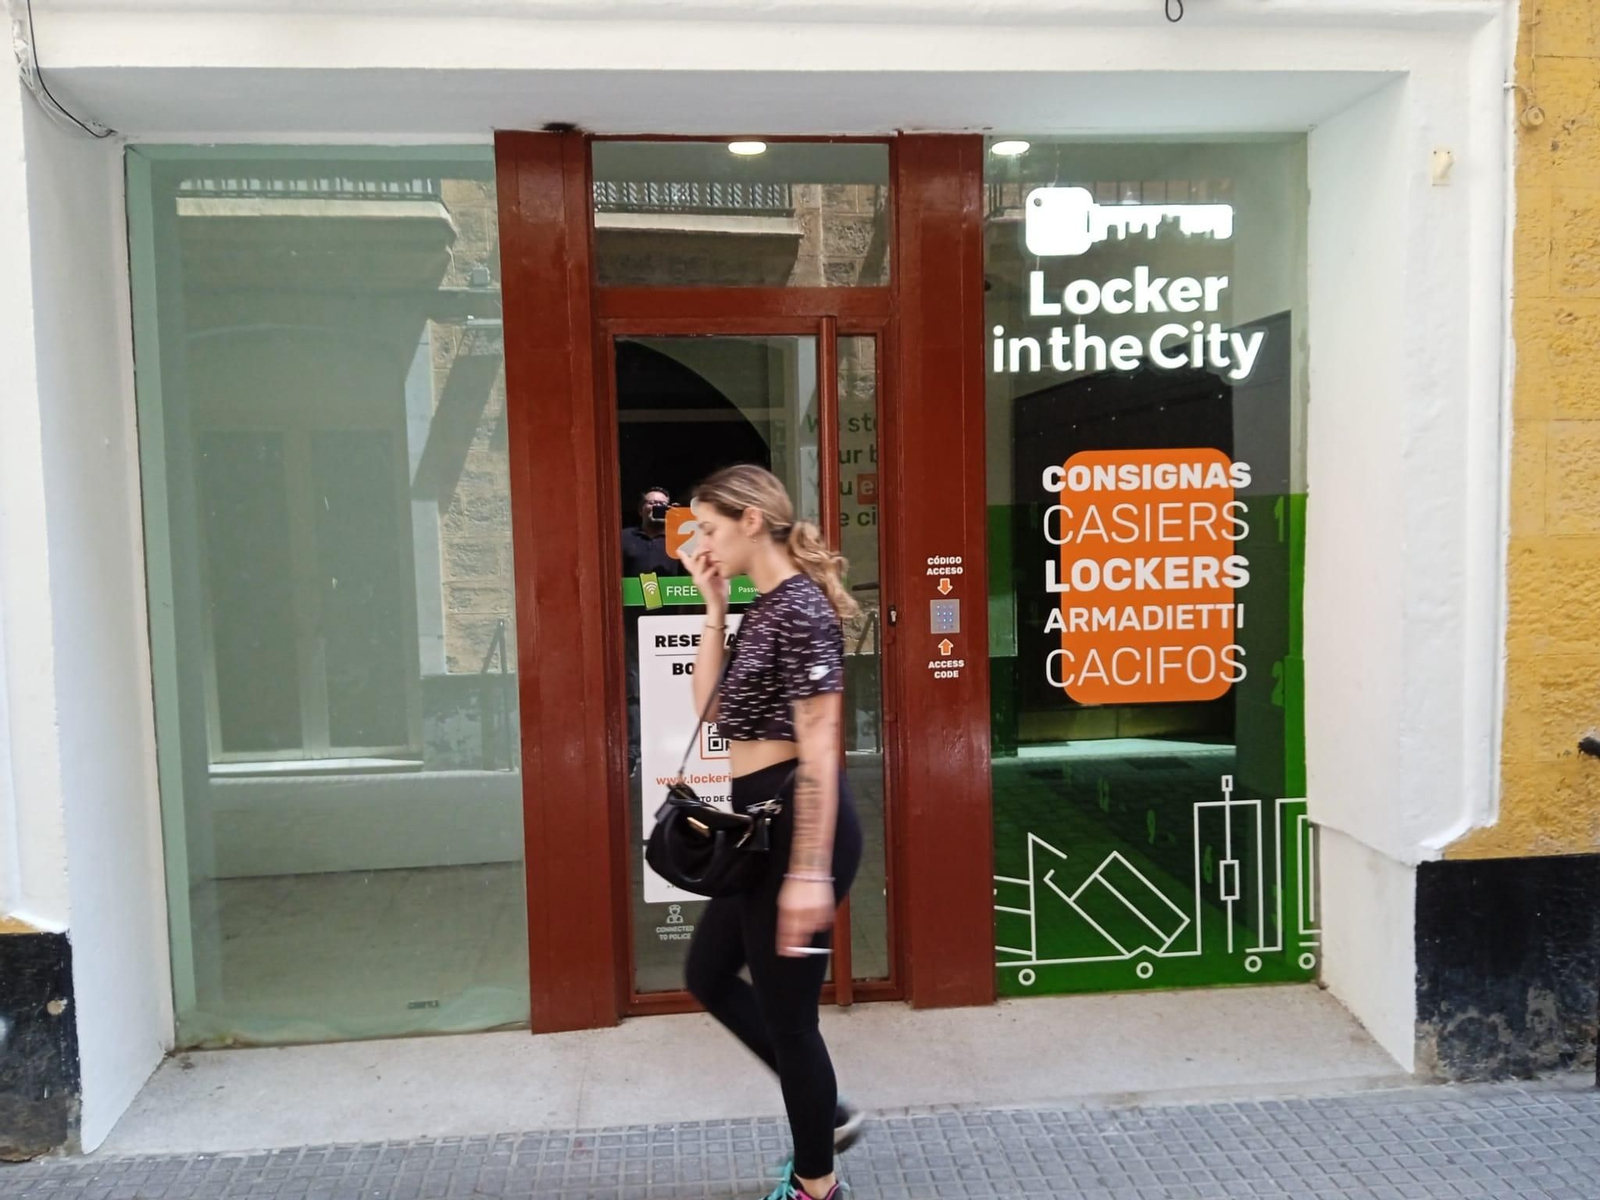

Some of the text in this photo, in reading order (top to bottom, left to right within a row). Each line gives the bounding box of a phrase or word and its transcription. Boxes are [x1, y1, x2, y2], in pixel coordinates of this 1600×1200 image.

[1030, 266, 1229, 316] Locker
[993, 320, 1264, 379] in the City
[1042, 462, 1252, 492] CONSIGNAS
[1043, 501, 1250, 545] CASIERS
[926, 566, 963, 576] ACCESO
[927, 555, 962, 566] CÓDIGO
[1045, 555, 1251, 593] LOCKERS
[666, 585, 698, 597] FREE
[1044, 603, 1244, 633] ARMADIETTI
[928, 660, 964, 669] ACCESS
[934, 670, 959, 679] CODE
[1045, 644, 1248, 688] CACIFOS
[669, 932, 691, 940] POLICE
